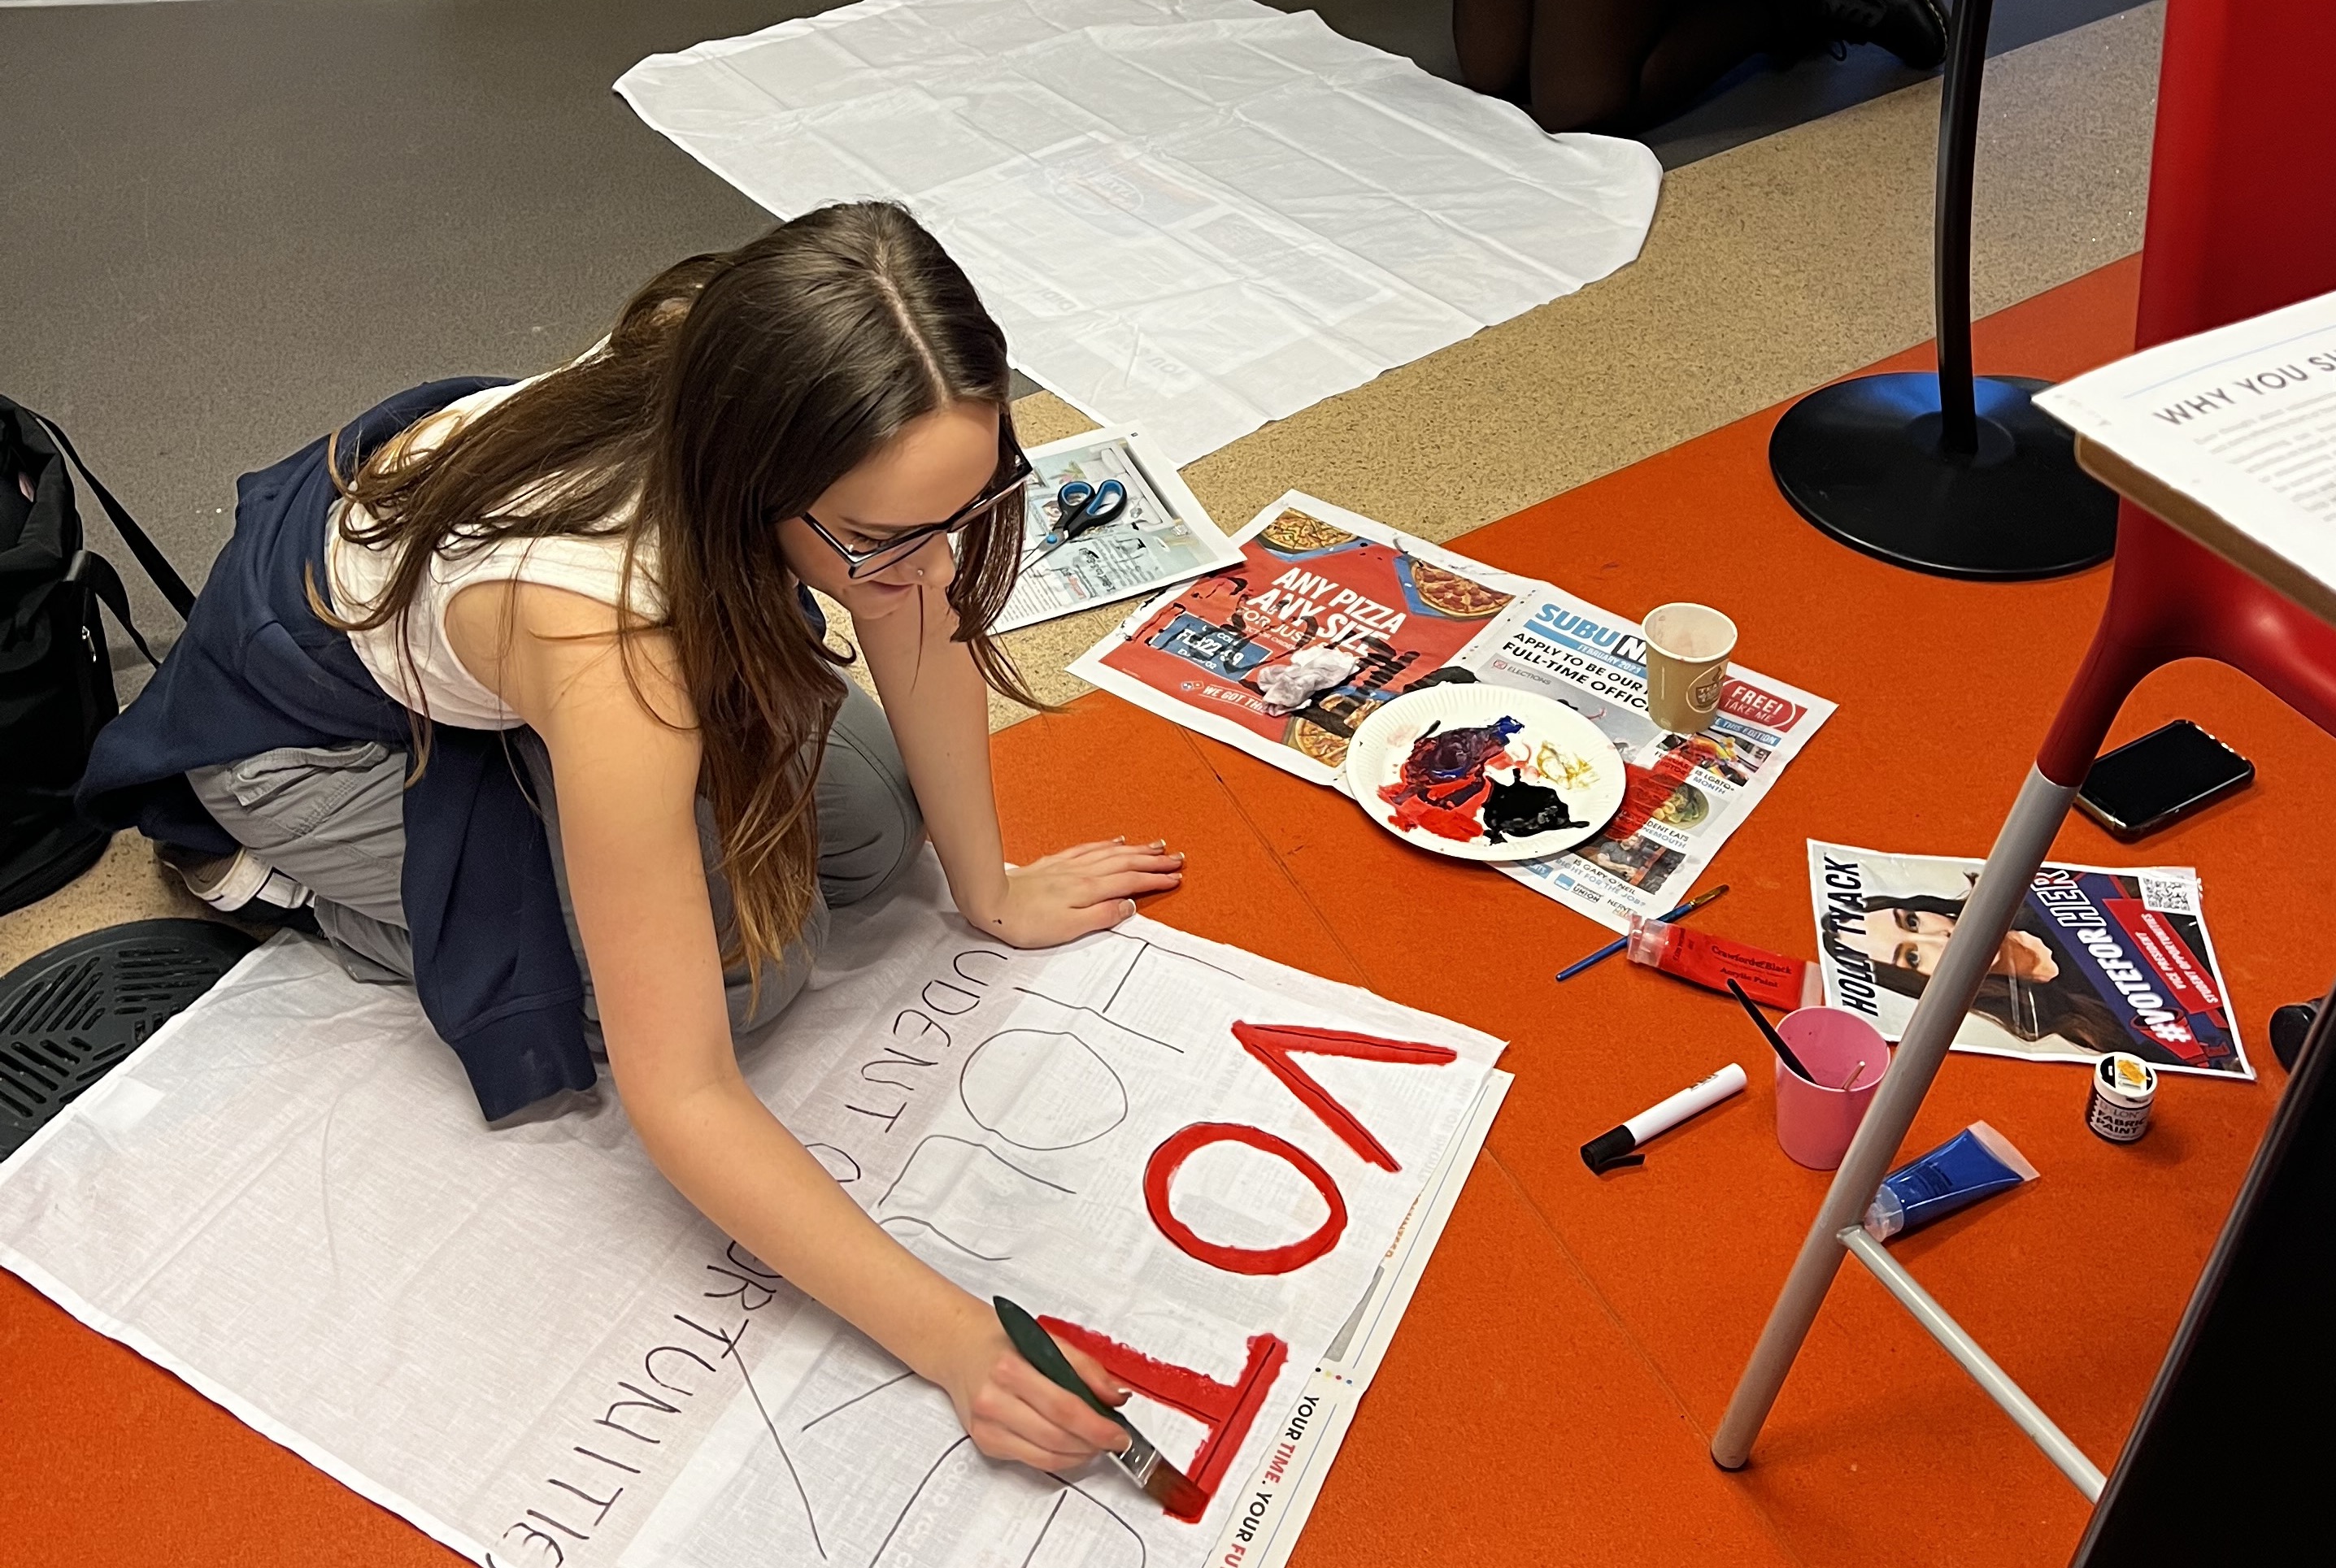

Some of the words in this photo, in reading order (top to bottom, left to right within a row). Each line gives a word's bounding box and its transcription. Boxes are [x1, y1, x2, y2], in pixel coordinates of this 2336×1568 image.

[2152, 388, 2234, 425] WHY
[2234, 363, 2308, 397] YOU
[1246, 588, 1327, 627] ANY
[1271, 567, 1339, 600] ANY
[1328, 588, 1407, 634] PIZZA
[1272, 623, 1312, 644] JUS
[1535, 603, 1620, 647] SUBU
[1503, 641, 1590, 684] FULL-TIME
[1512, 632, 1562, 657] APPLY
[1563, 653, 1584, 667] TO
[1586, 663, 1607, 676] BE
[1607, 672, 1643, 693] OUR
[1577, 644, 1620, 666] FEBRUARY
[1507, 666, 1552, 686] ELECTIONS
[1203, 685, 1221, 698] WE
[1221, 690, 1247, 706] GOT
[1244, 697, 1264, 713] THI
[1724, 697, 1753, 716] TAKE
[1754, 711, 1776, 723] ME
[1730, 684, 1785, 716] FREE!
[1722, 721, 1744, 733] THIS
[1742, 727, 1777, 745] EDITION
[1692, 775, 1726, 795] MONTH
[1668, 829, 1690, 842] EATS
[1555, 858, 1584, 876] RIGHT
[1584, 872, 1603, 886] FOR
[1603, 882, 1621, 895] THE
[1620, 893, 1647, 907] JOB?
[1573, 885, 1600, 903] UNION
[1582, 863, 1608, 880] GARY
[1608, 878, 1637, 895] O'NEIL
[1824, 854, 1867, 935] TYACK
[1753, 975, 1778, 988] Paint
[1834, 937, 1879, 1017] HOLLY
[2183, 971, 2219, 1004] STUDENT
[844, 949, 1008, 1134] UDENT
[2095, 1116, 2139, 1134] PAINT
[2098, 1109, 2146, 1127] FABRIC
[1285, 1396, 1320, 1440] YOUR
[1262, 1442, 1296, 1484] TIME.
[1235, 1492, 1272, 1543] YOUR
[1220, 1542, 1246, 1568] FU
